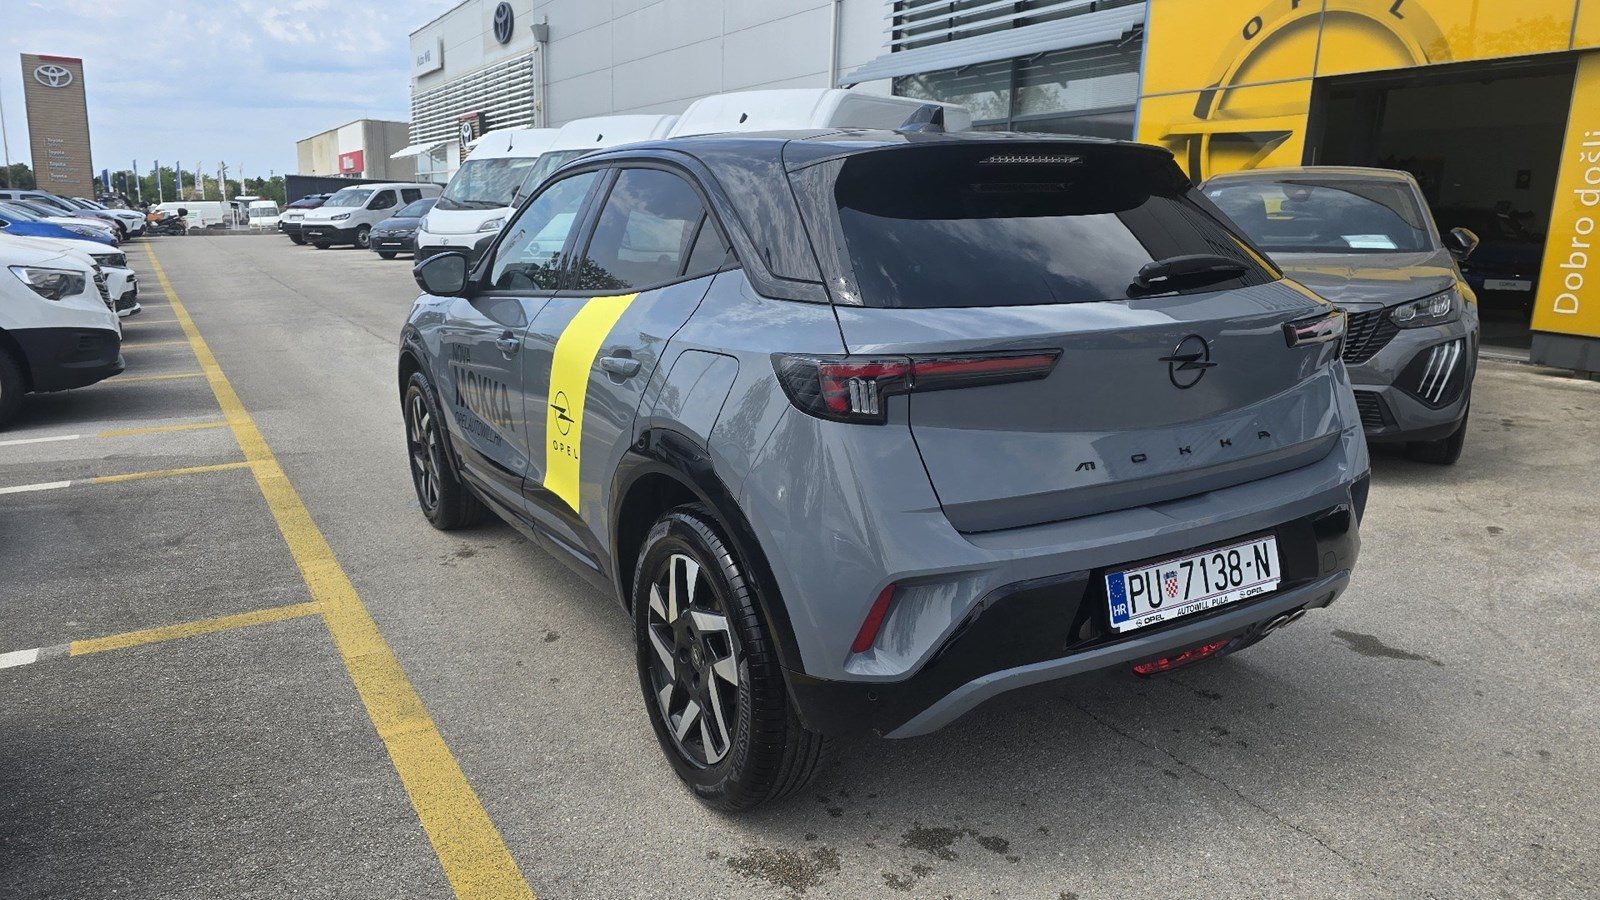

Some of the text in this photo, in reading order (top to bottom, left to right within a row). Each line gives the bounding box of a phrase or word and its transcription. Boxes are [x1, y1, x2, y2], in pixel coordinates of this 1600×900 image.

[1553, 130, 1600, 315] Dobro došli
[452, 343, 471, 364] NOVA
[454, 366, 515, 432] MOKKA
[553, 440, 579, 460] OPEL
[1075, 430, 1271, 472] MOKKA
[1128, 542, 1271, 614] PU 7138-N
[1246, 587, 1264, 596] OPEL
[1113, 603, 1127, 616] HR
[1177, 595, 1229, 616] AUTOWILL PULA
[1144, 615, 1165, 624] OPEL
